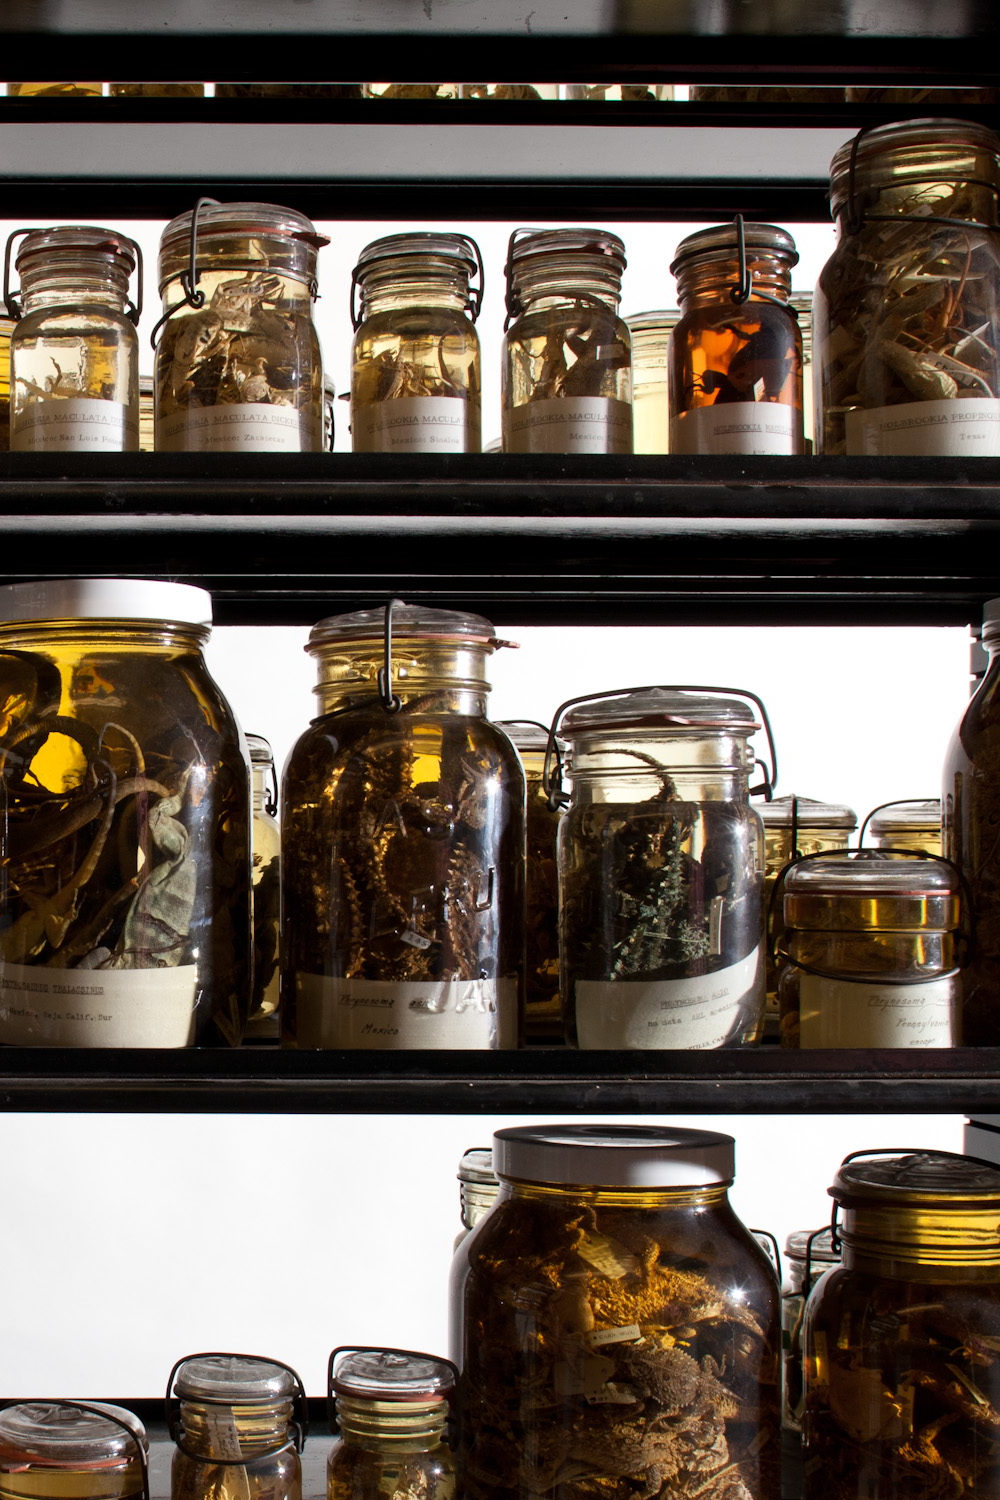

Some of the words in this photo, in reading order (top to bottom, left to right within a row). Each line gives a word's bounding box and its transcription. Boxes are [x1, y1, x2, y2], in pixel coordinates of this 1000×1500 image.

[54, 413, 108, 422] MACULATA
[213, 414, 268, 423] MACULATA
[880, 415, 948, 430] HOLBROOKIA
[714, 424, 761, 434] HOLBROOKIA
[59, 433, 75, 441] San
[960, 433, 986, 441] Texas
[66, 1012, 94, 1021] Calif.
[97, 1012, 113, 1021] Sur
[662, 1018, 682, 1027] data
[361, 1022, 400, 1035] Mexico
